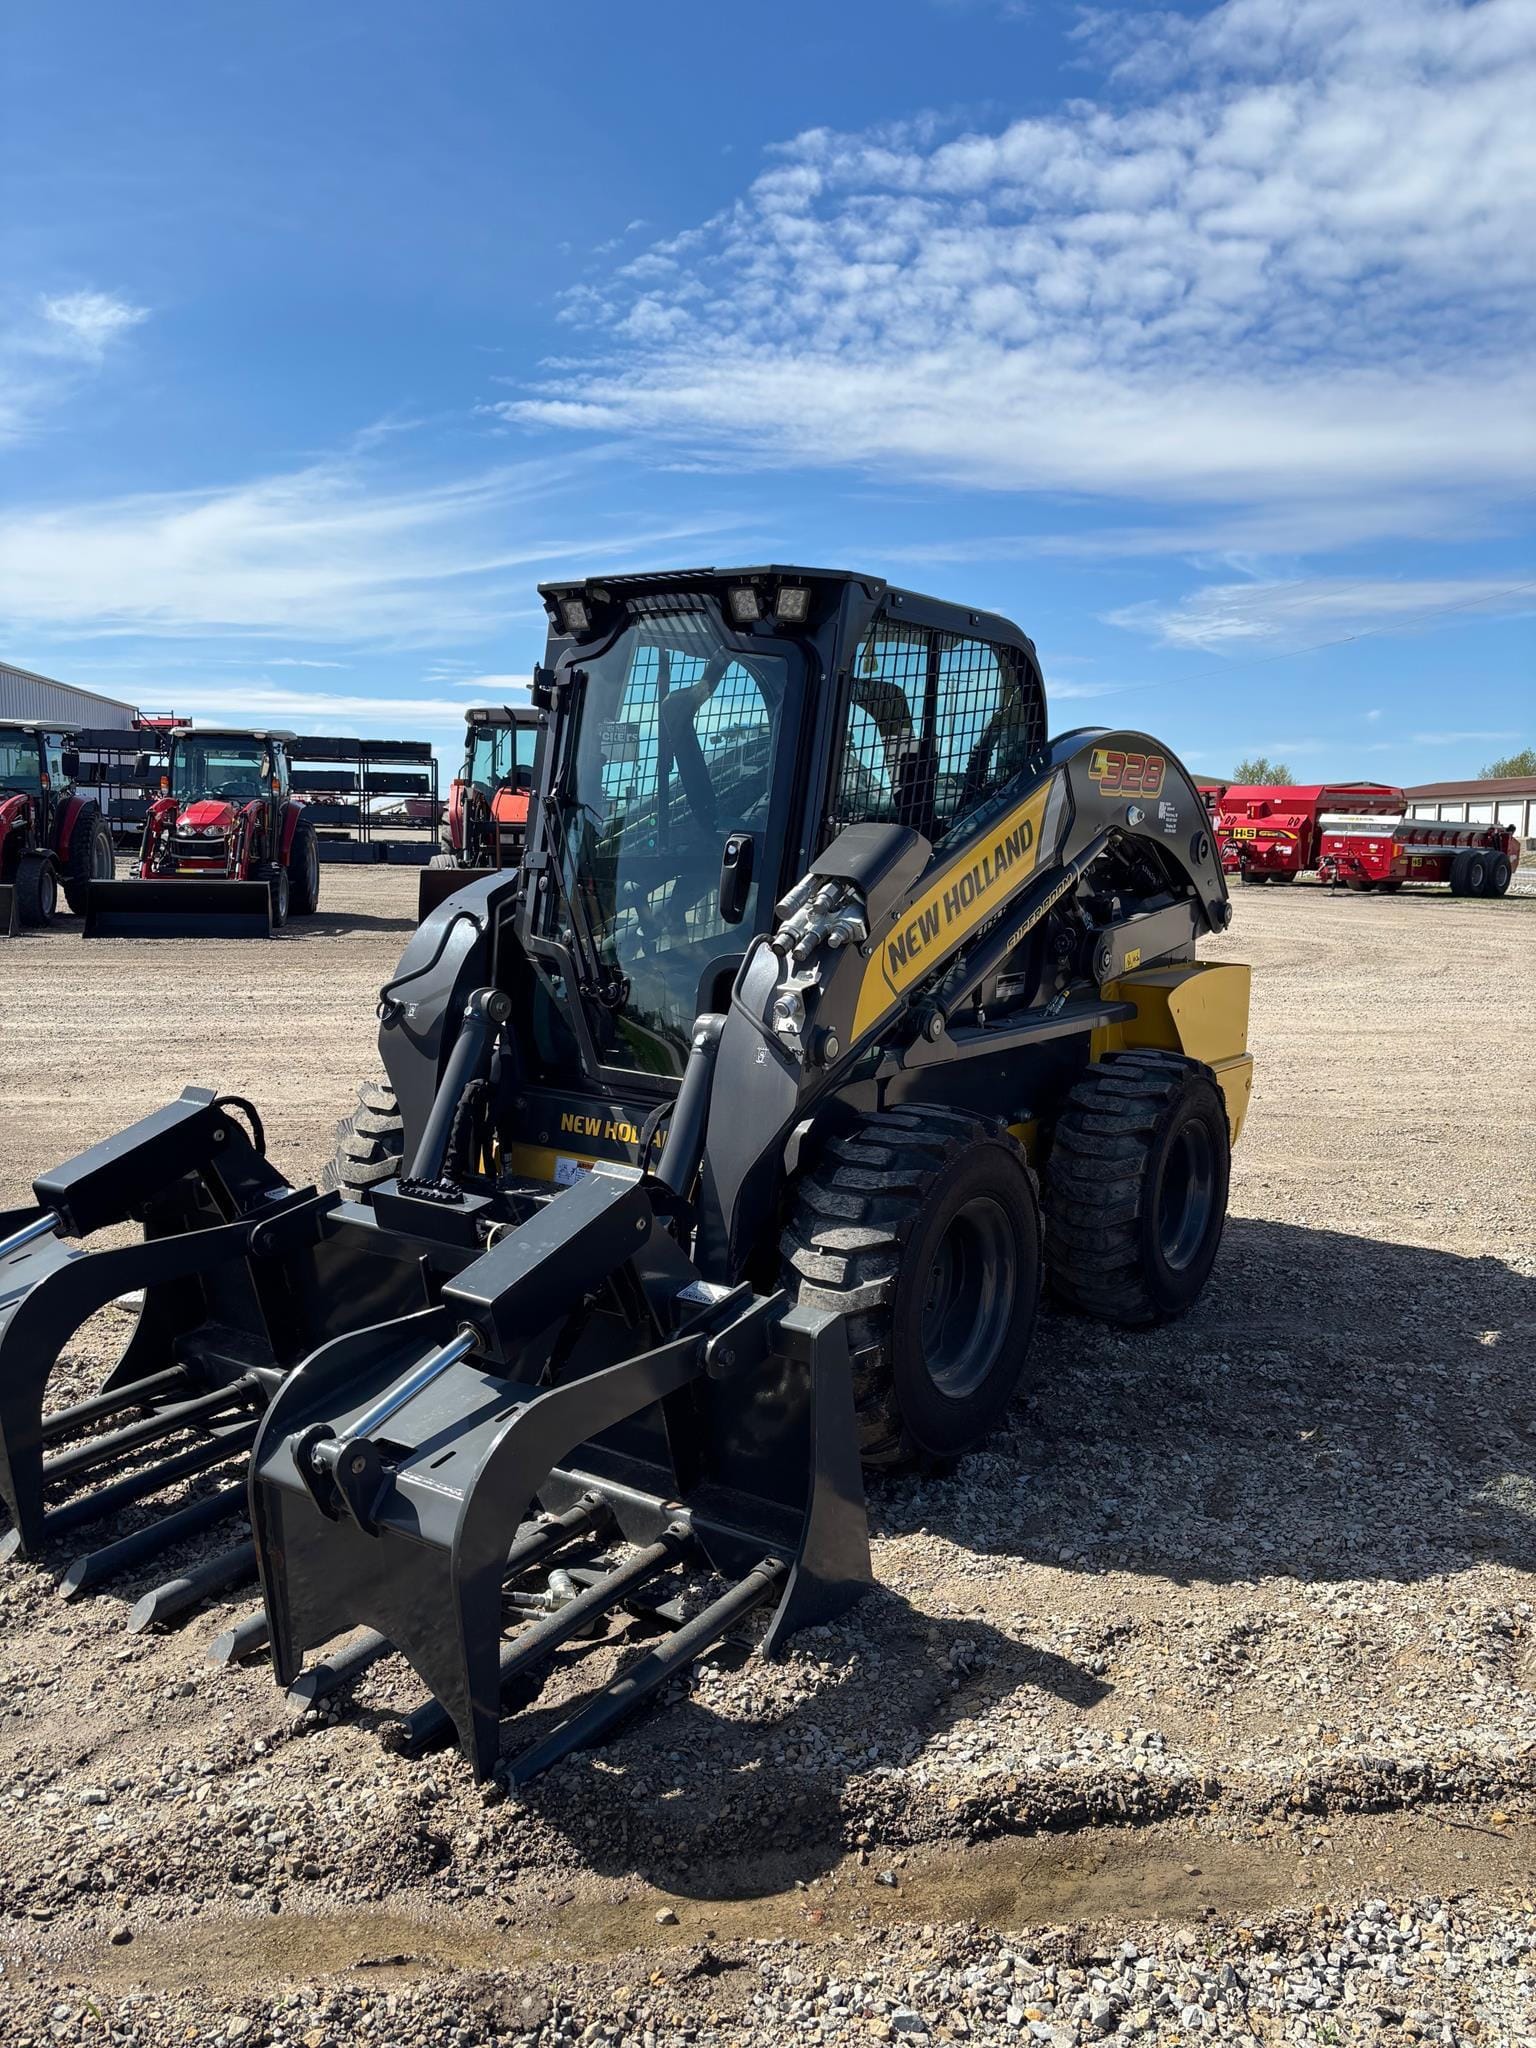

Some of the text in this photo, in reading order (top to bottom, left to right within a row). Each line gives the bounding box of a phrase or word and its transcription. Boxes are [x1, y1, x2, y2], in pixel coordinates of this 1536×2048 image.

[887, 819, 1034, 976] NEW HOLLAND
[561, 1112, 602, 1137] NEW
